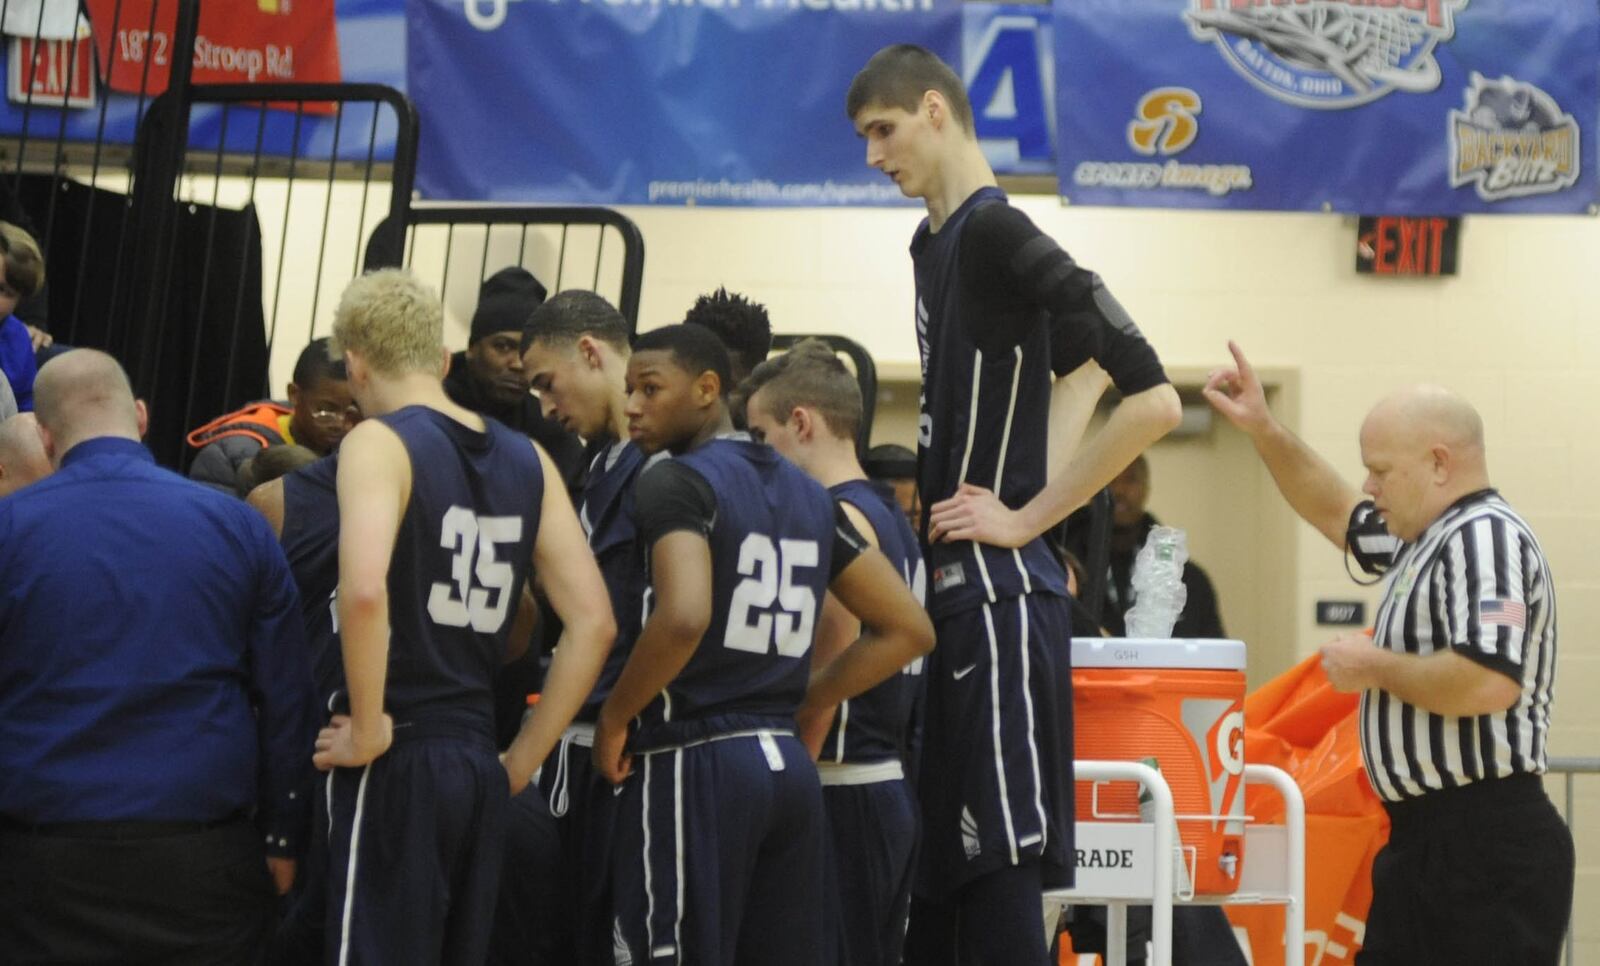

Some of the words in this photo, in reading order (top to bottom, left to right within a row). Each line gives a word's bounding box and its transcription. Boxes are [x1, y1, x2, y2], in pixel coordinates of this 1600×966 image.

[193, 35, 263, 82] Stroop
[1376, 215, 1449, 275] EXIT
[427, 505, 522, 634] 35
[723, 531, 819, 658] 25
[1217, 711, 1244, 775] G
[1075, 849, 1133, 868] RADE
